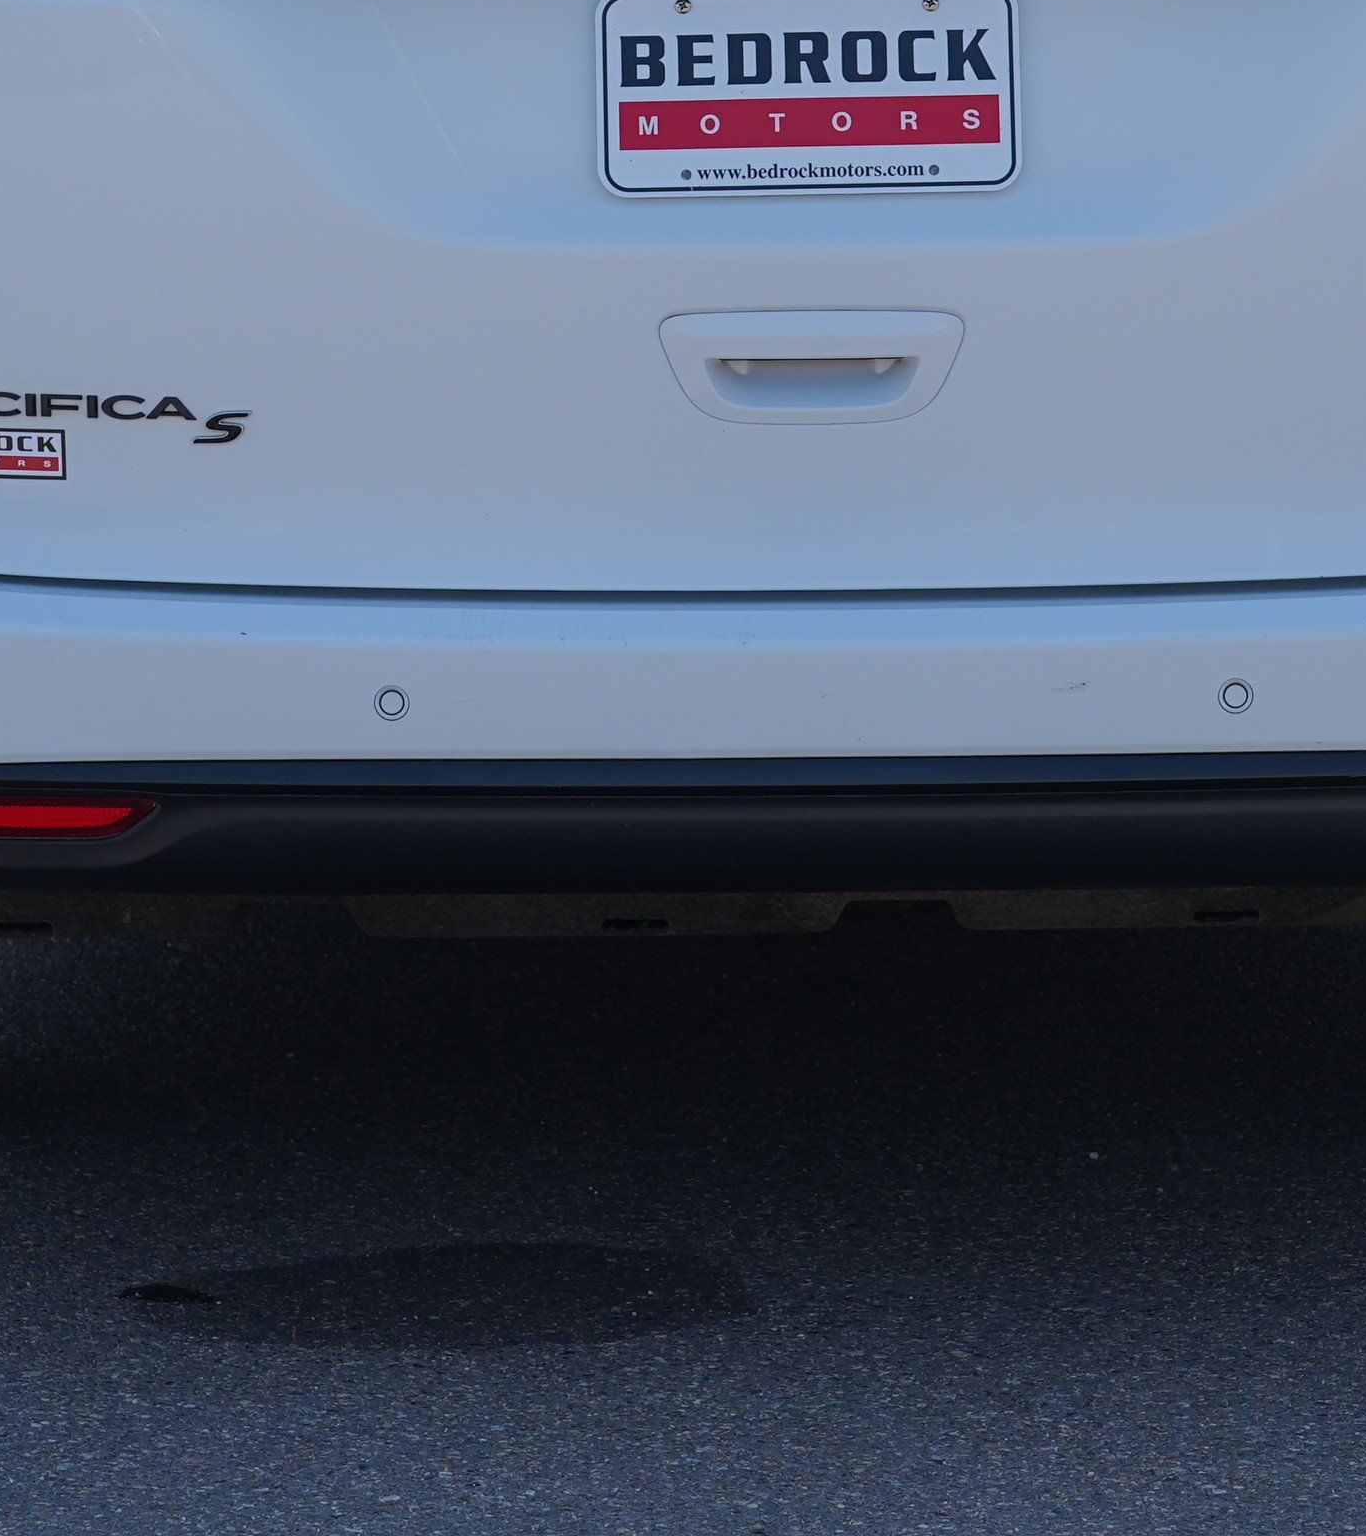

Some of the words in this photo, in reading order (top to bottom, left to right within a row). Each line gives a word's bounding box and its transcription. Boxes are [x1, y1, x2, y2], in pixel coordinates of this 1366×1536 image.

[620, 28, 997, 88] BEDROCK
[638, 109, 981, 136] MOTORS
[697, 162, 925, 181] www.bedrockmotors.com
[193, 409, 251, 444] S
